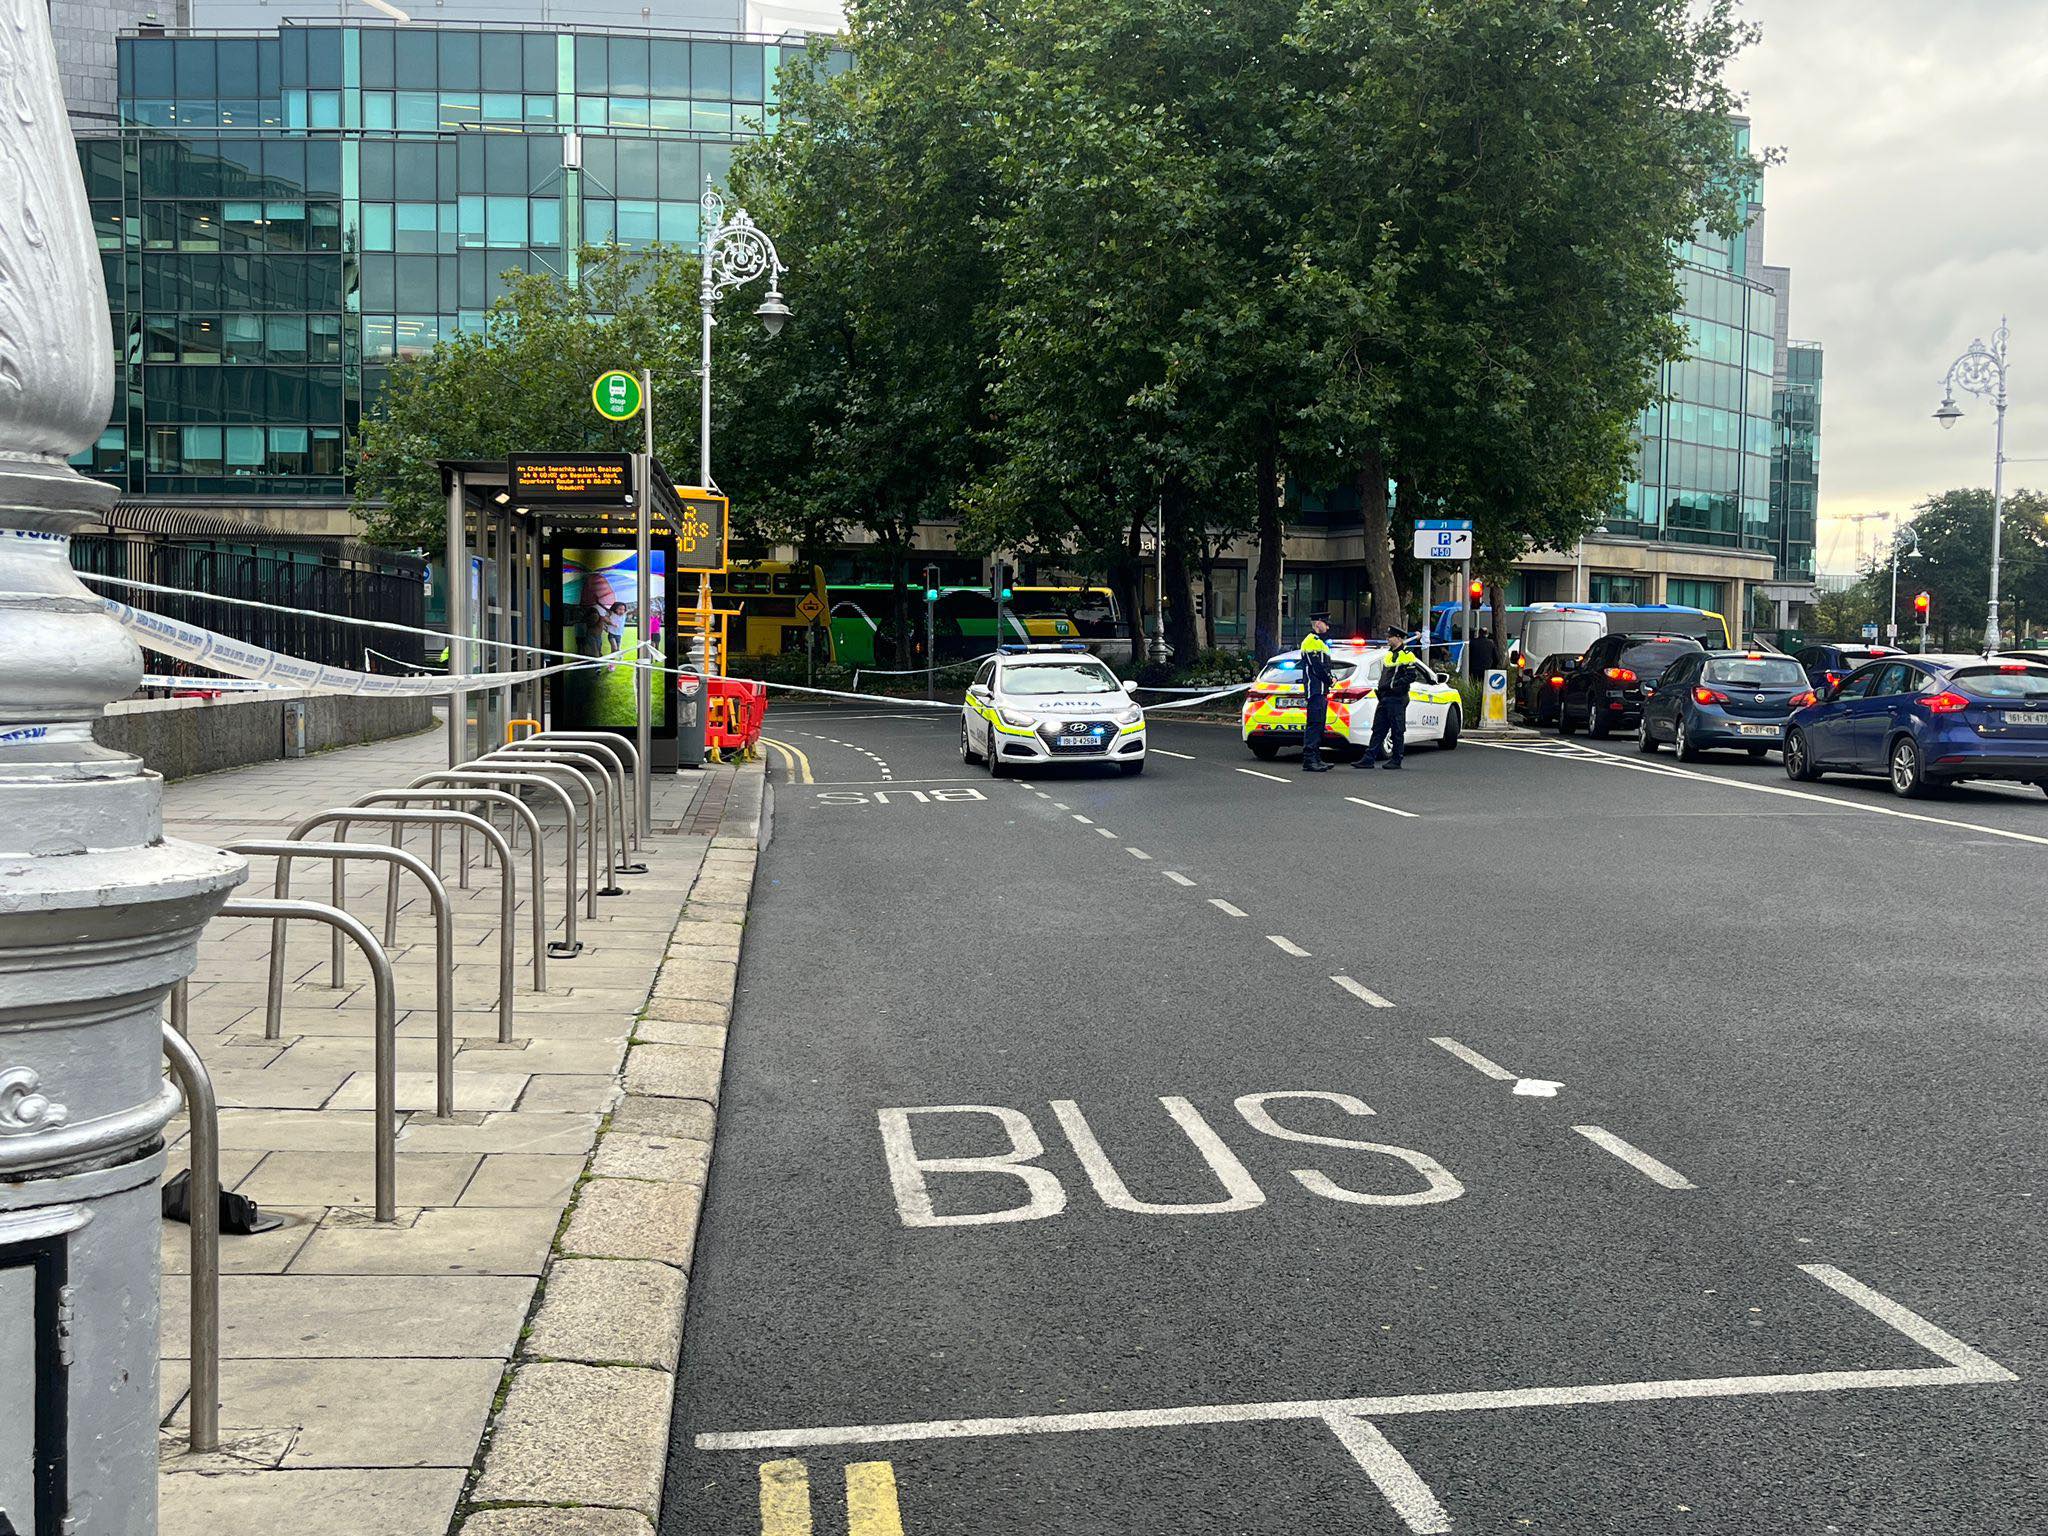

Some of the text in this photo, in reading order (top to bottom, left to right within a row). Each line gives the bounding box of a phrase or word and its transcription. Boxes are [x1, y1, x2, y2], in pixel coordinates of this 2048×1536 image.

[610, 397, 626, 405] Stop
[1056, 624, 1068, 632] TFI
[1039, 700, 1102, 708] GARDA
[1421, 715, 1439, 727] GARDA
[816, 788, 988, 805] BUS
[877, 1090, 1465, 1228] BUS
